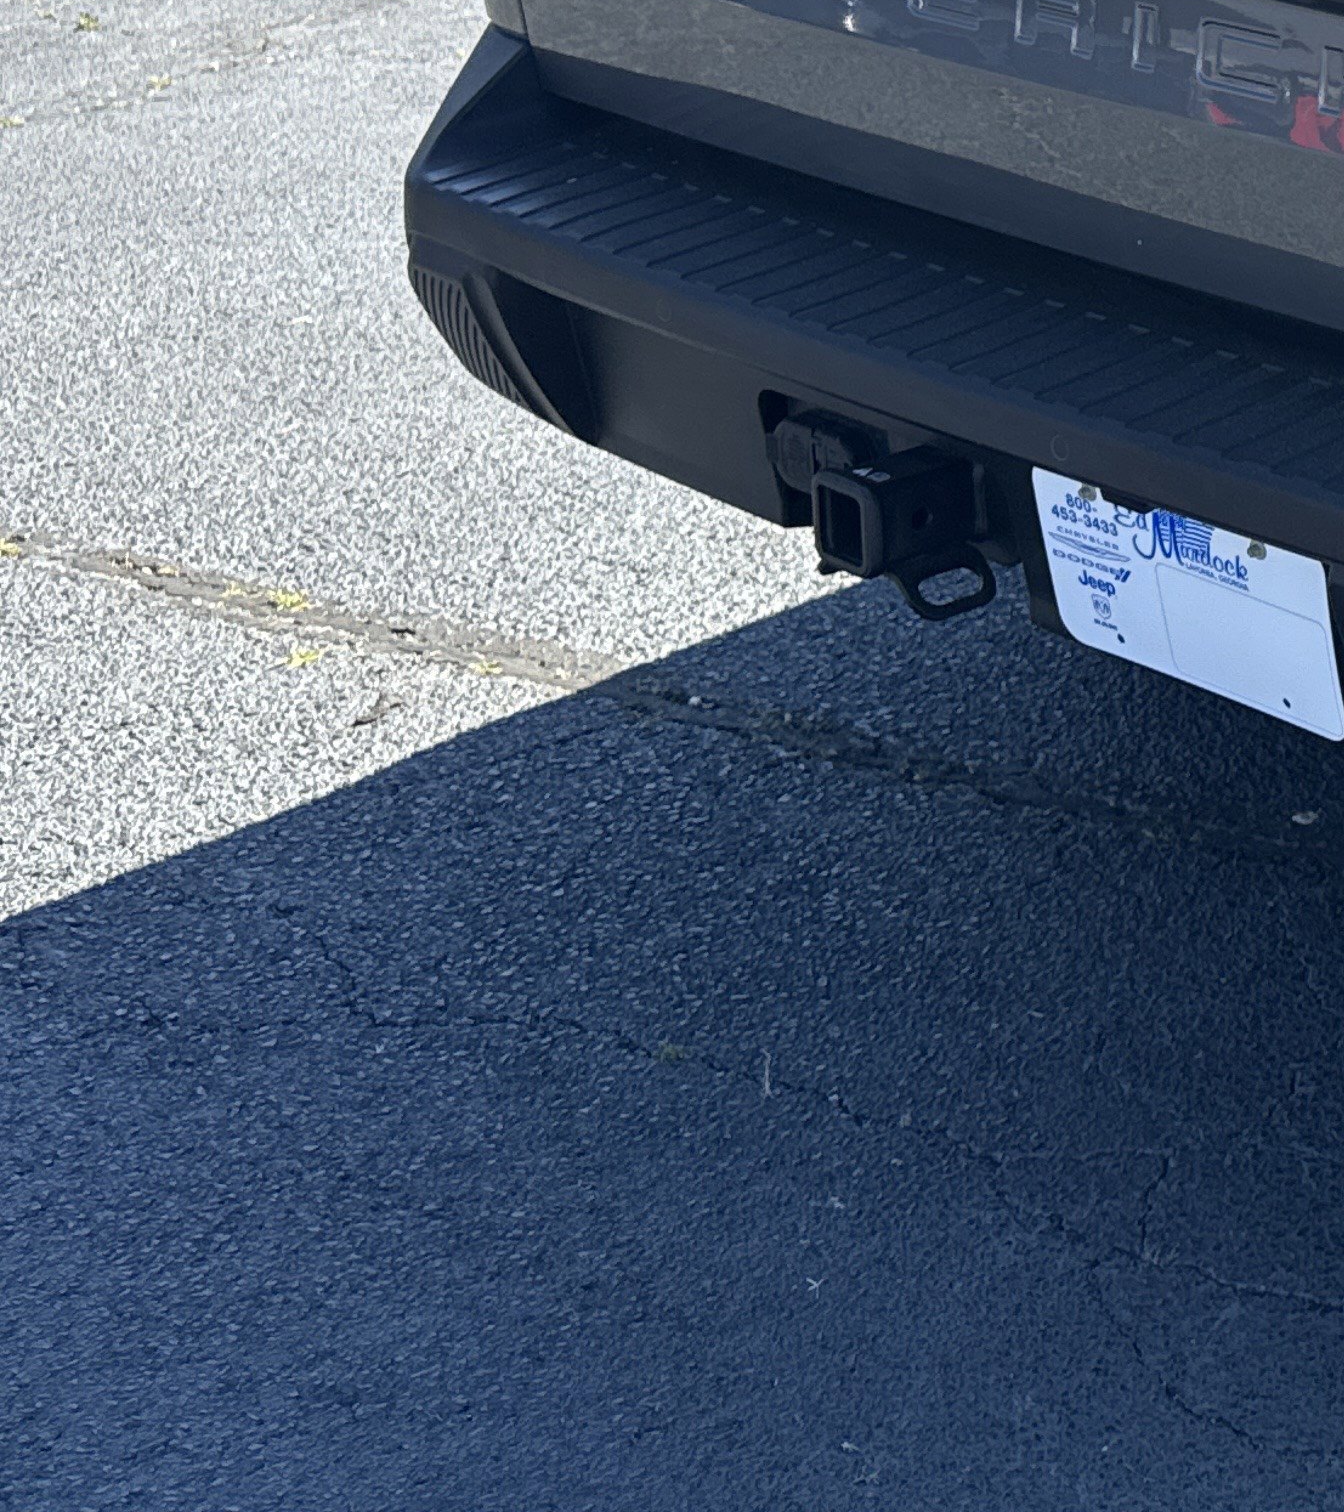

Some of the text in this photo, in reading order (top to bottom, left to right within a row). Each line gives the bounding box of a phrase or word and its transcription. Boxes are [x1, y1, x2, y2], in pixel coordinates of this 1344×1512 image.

[1065, 492, 1098, 513] 800-
[1051, 504, 1118, 537] 453-3433
[1056, 525, 1119, 551] CHRYSLER
[1052, 548, 1122, 576] DODGE
[1078, 569, 1116, 598] Jeep
